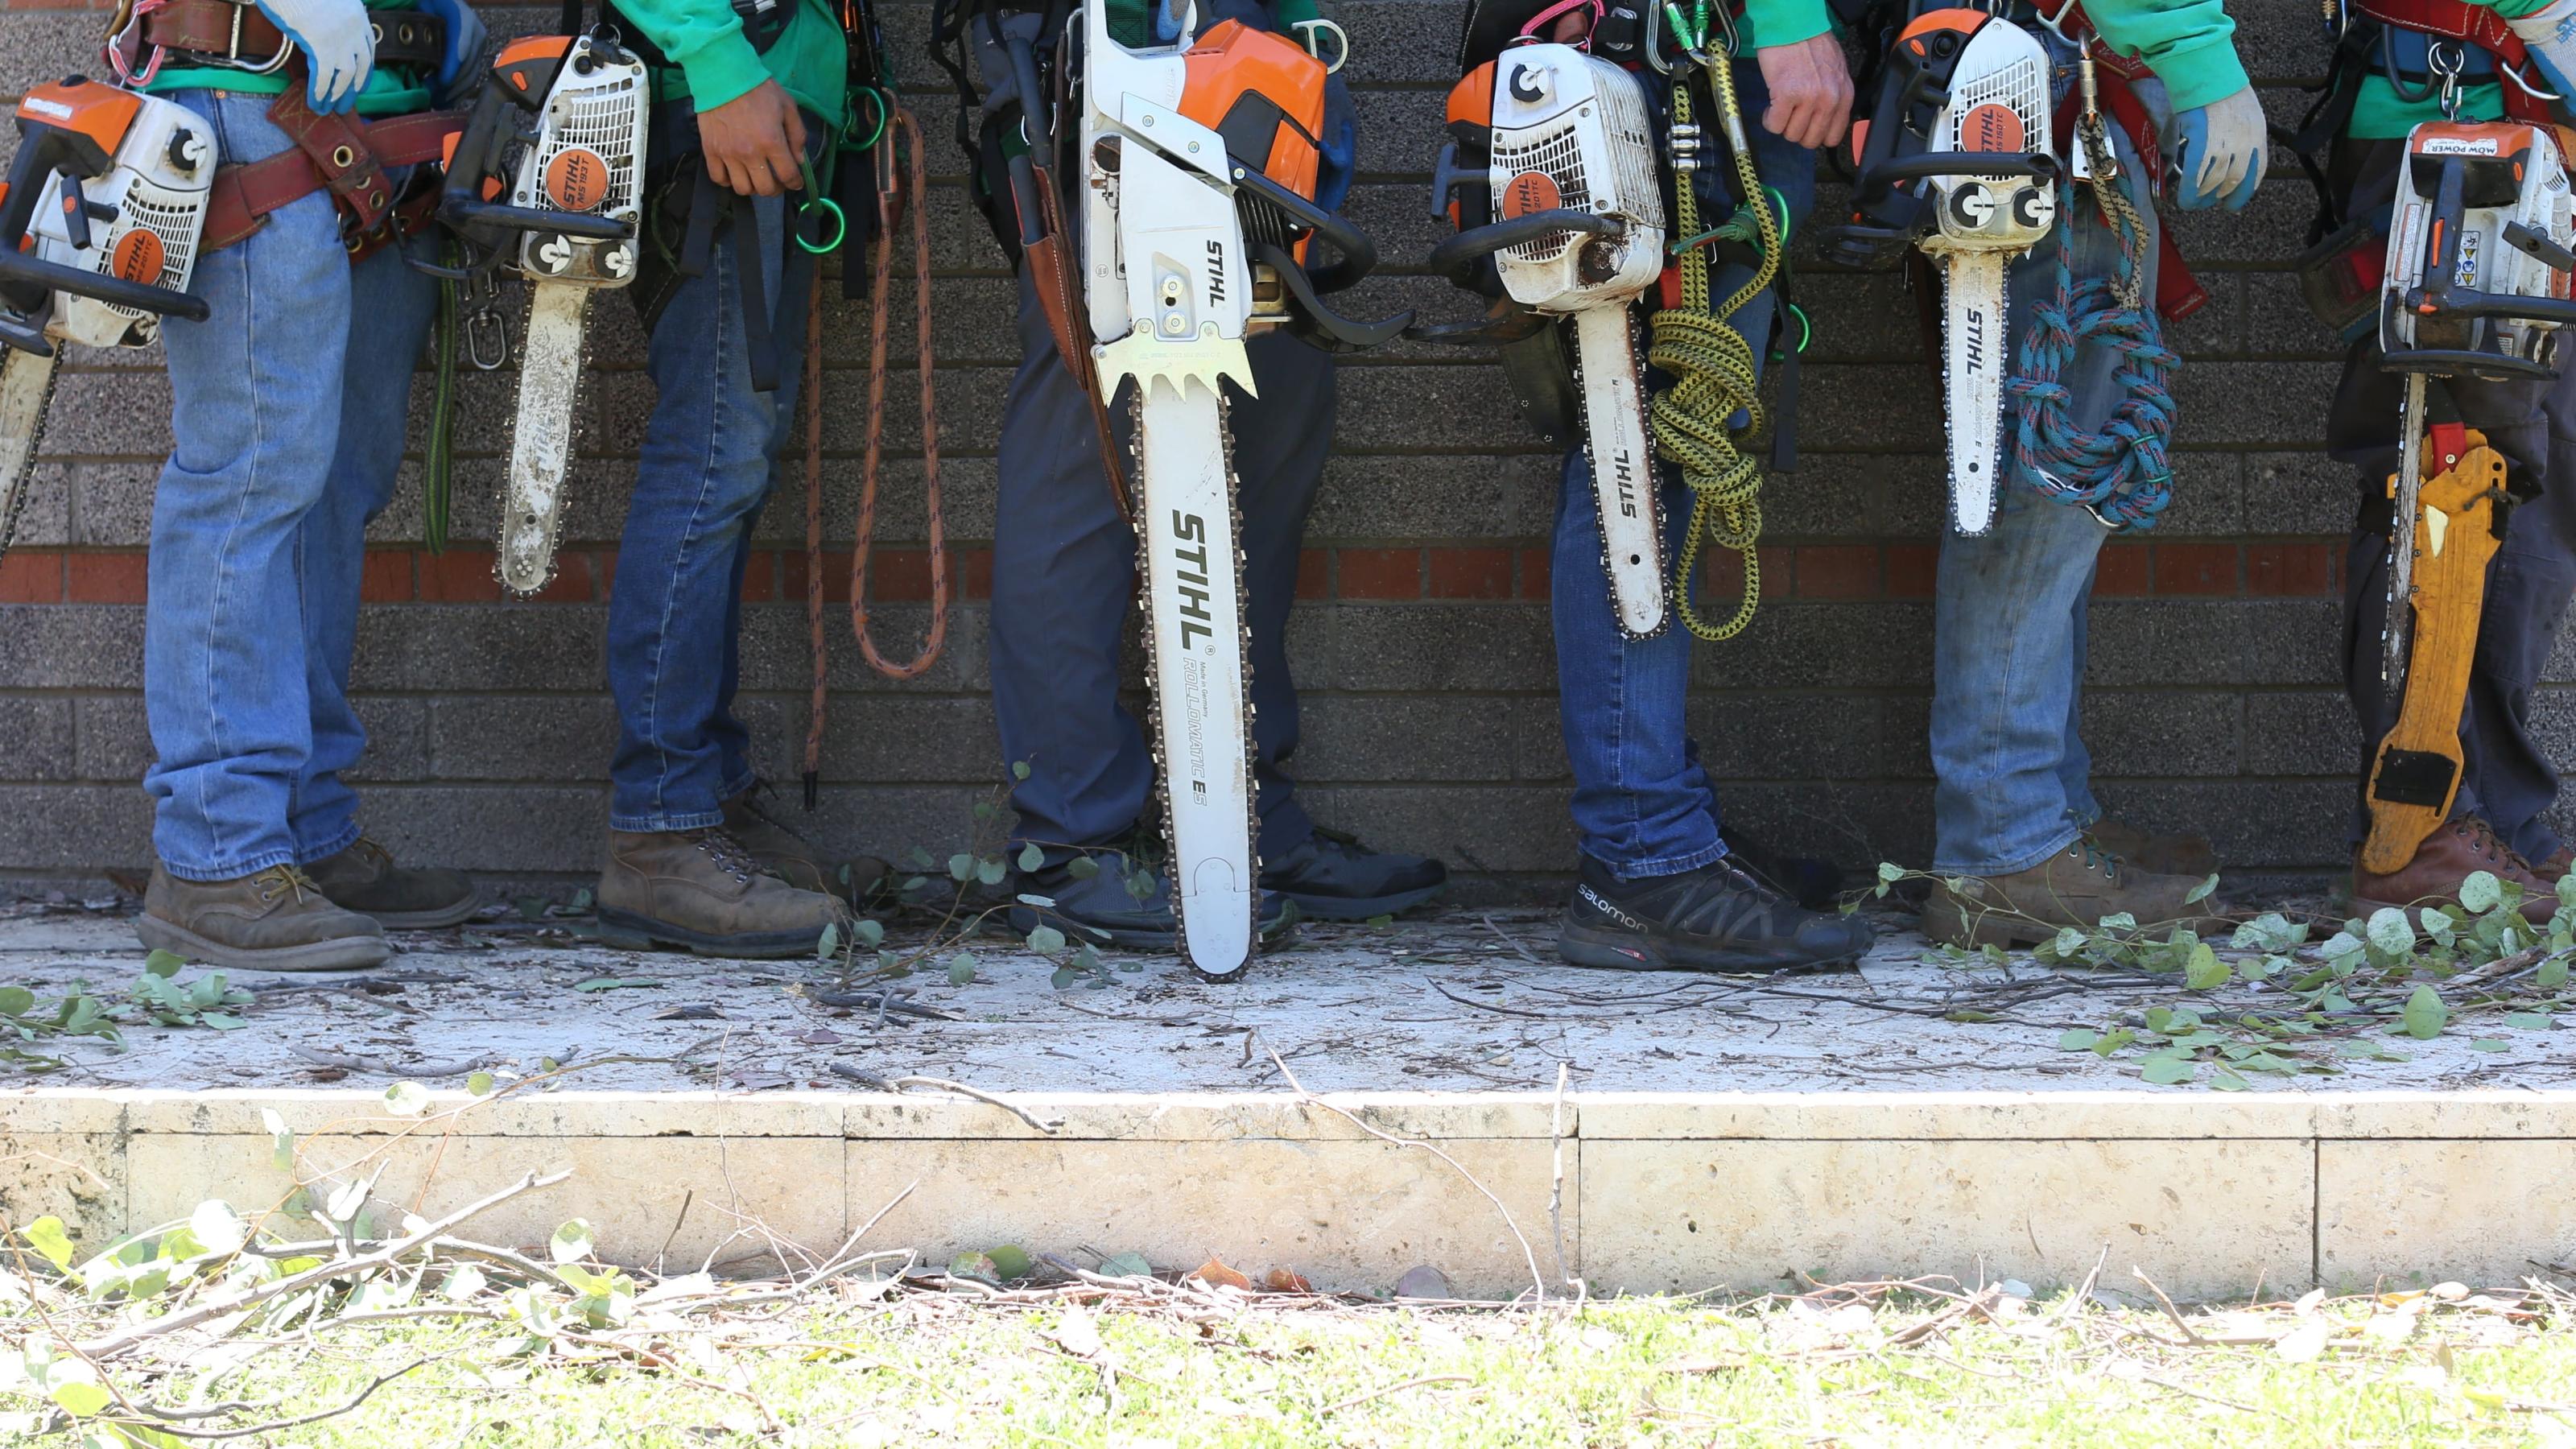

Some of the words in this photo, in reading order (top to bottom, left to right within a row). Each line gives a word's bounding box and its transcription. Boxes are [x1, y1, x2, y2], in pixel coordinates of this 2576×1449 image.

[564, 155, 580, 206] STIHL
[577, 185, 586, 204] MS
[1207, 240, 1225, 308] STIHL
[1967, 308, 1983, 375] STIHL
[1615, 449, 1637, 518] STIHL
[1172, 509, 1212, 650] STIHL
[1183, 657, 1205, 778] ROLLOMATIC
[1192, 779, 1208, 807] ES
